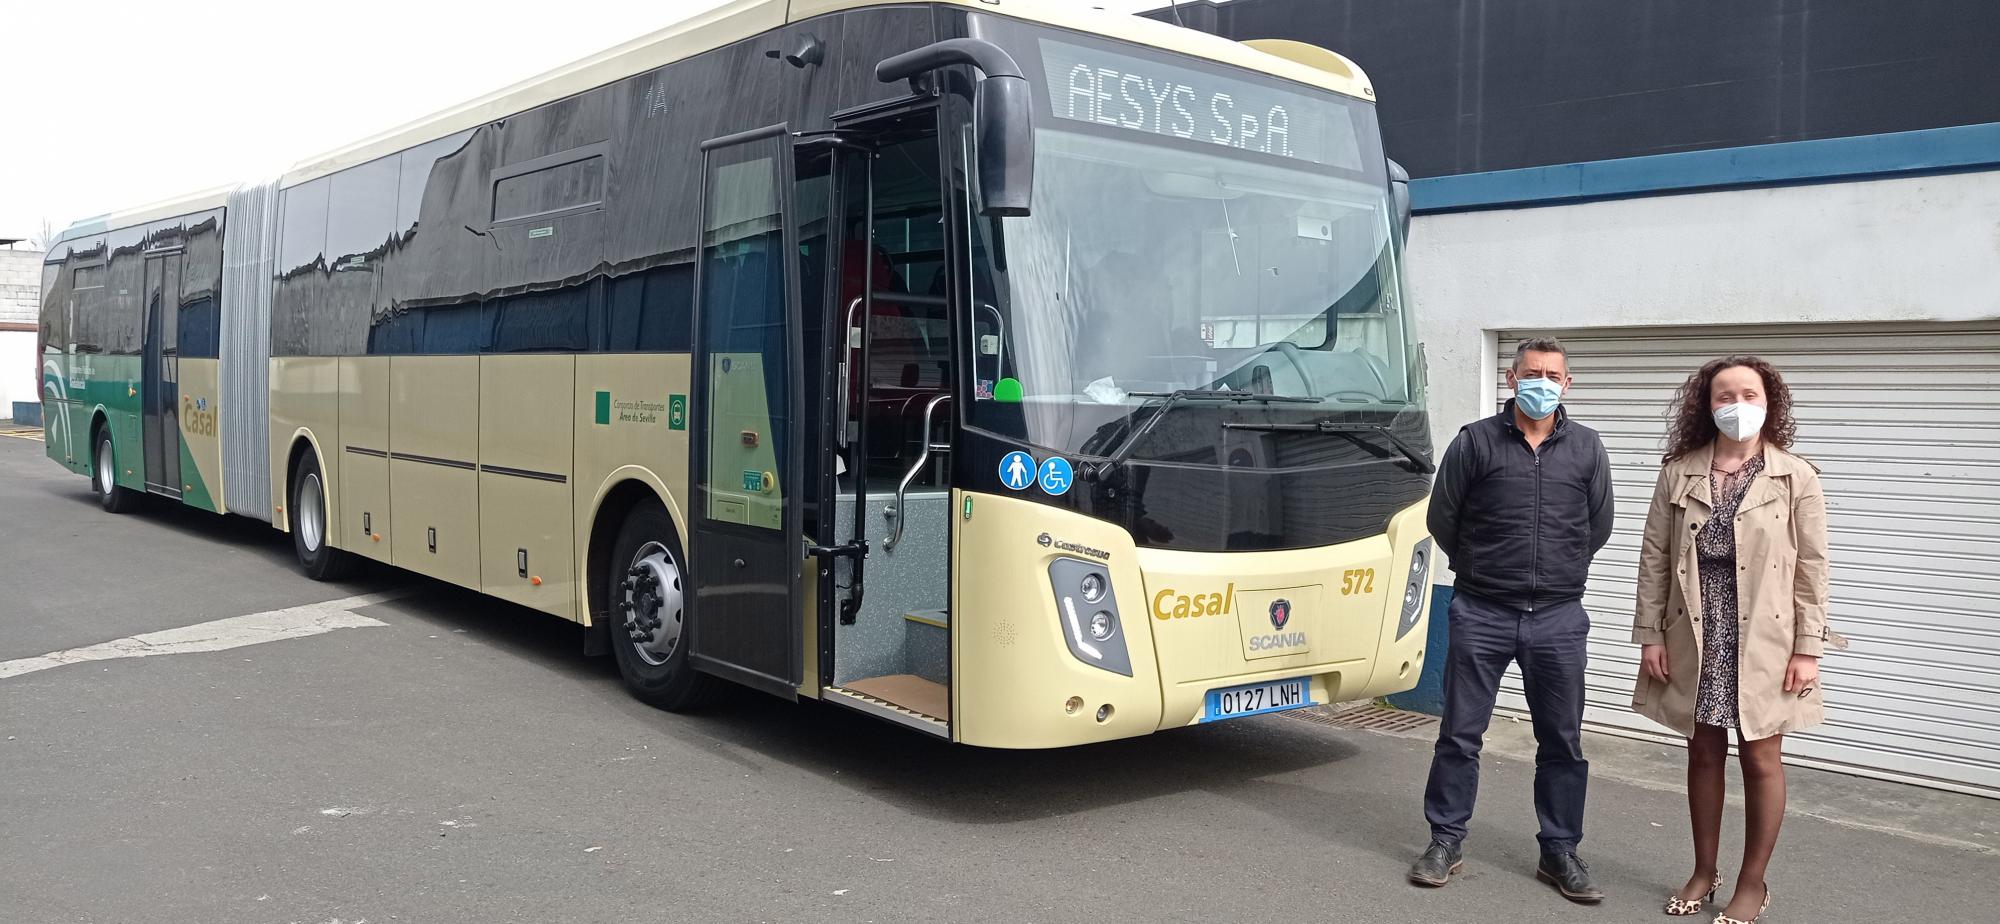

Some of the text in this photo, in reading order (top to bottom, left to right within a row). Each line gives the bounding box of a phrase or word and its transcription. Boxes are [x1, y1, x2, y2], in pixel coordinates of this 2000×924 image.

[1069, 64, 1196, 139] AESYS
[184, 402, 218, 438] Casal
[632, 411, 639, 422] de
[1054, 540, 1111, 560] Castrosua
[1341, 568, 1375, 596] 572
[1153, 582, 1234, 621] Casal
[1249, 631, 1307, 652] SCANIA
[1223, 688, 1264, 714] 0127
[1270, 683, 1300, 707] LNH
